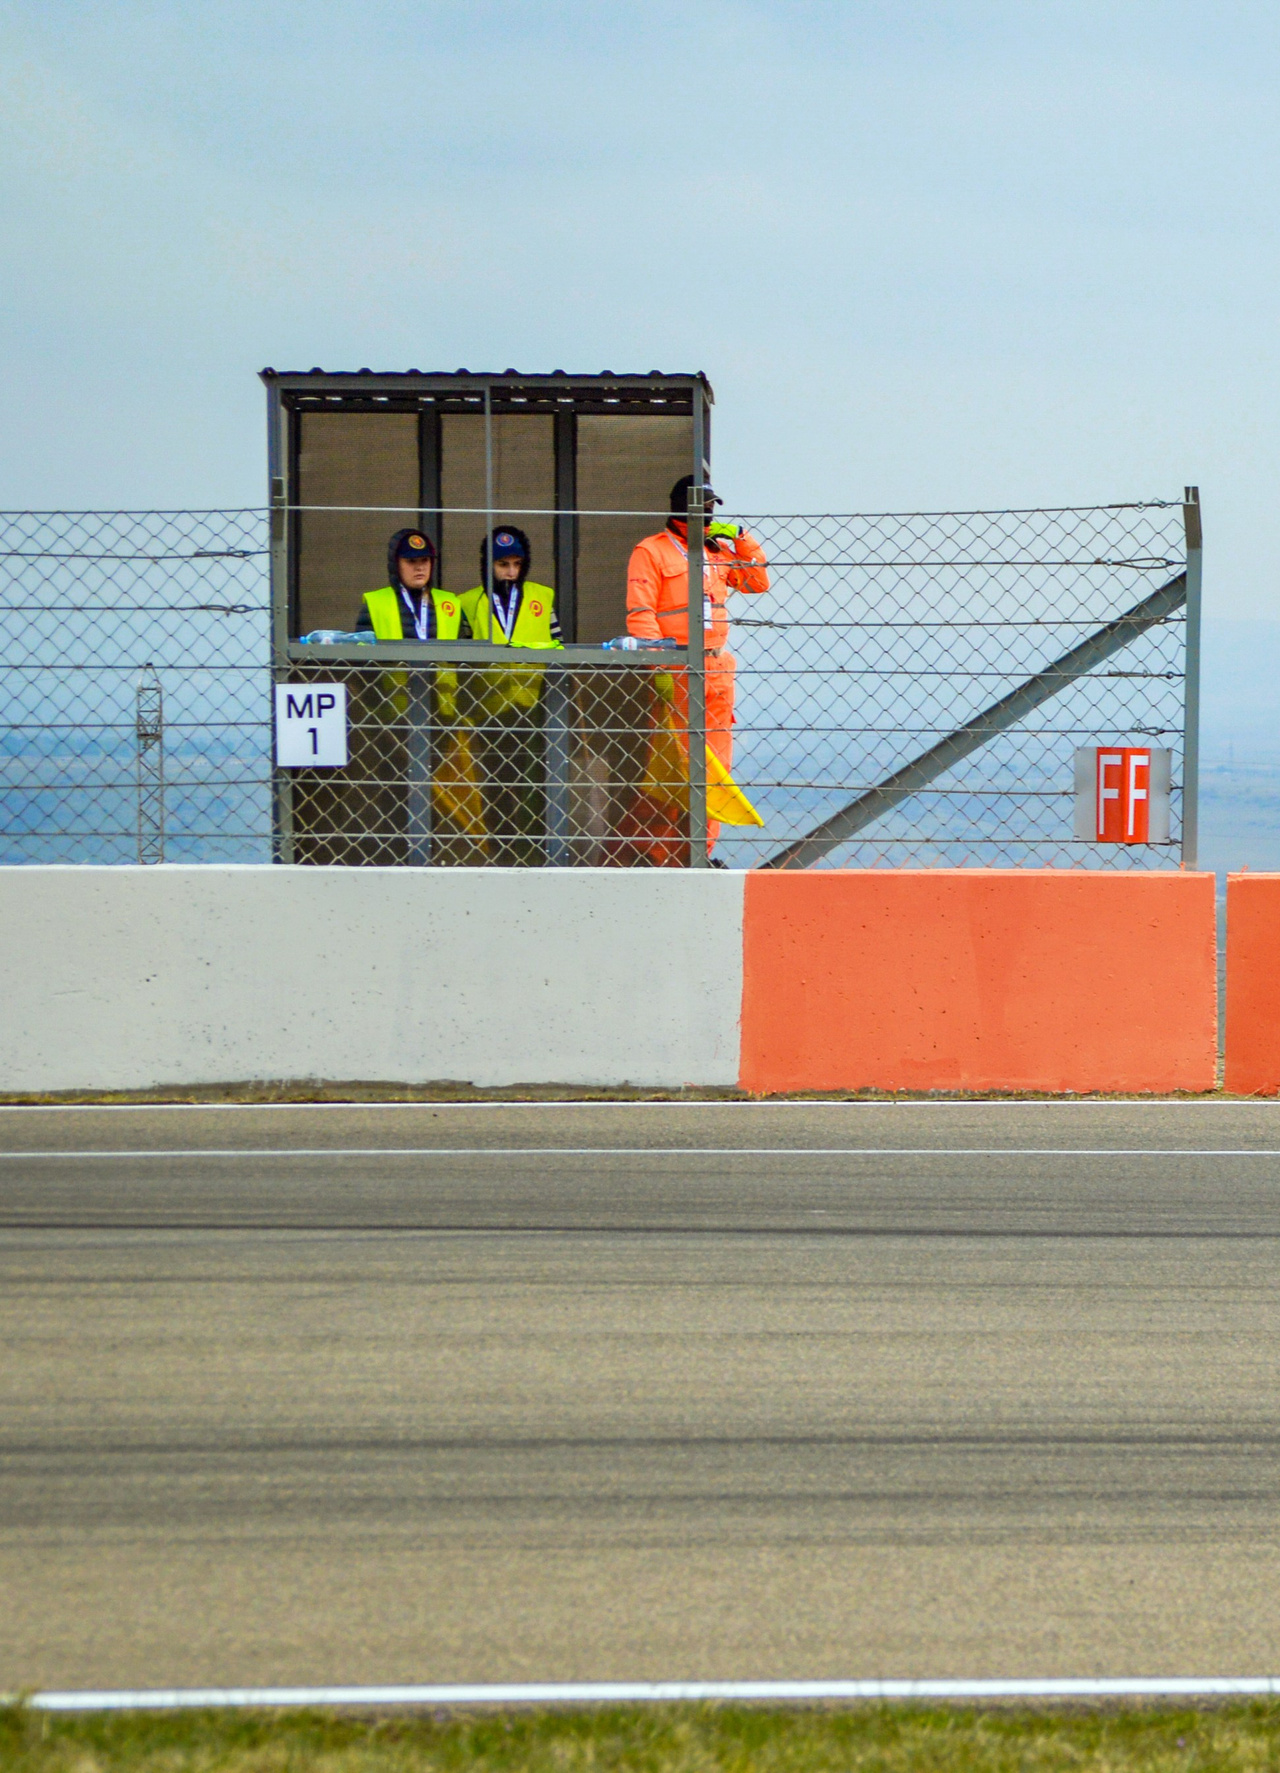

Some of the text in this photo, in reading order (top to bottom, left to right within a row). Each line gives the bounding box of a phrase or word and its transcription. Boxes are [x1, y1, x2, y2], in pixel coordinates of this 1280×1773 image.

[287, 693, 335, 718] MP
[307, 727, 318, 755] 1
[1099, 754, 1149, 836] FF
